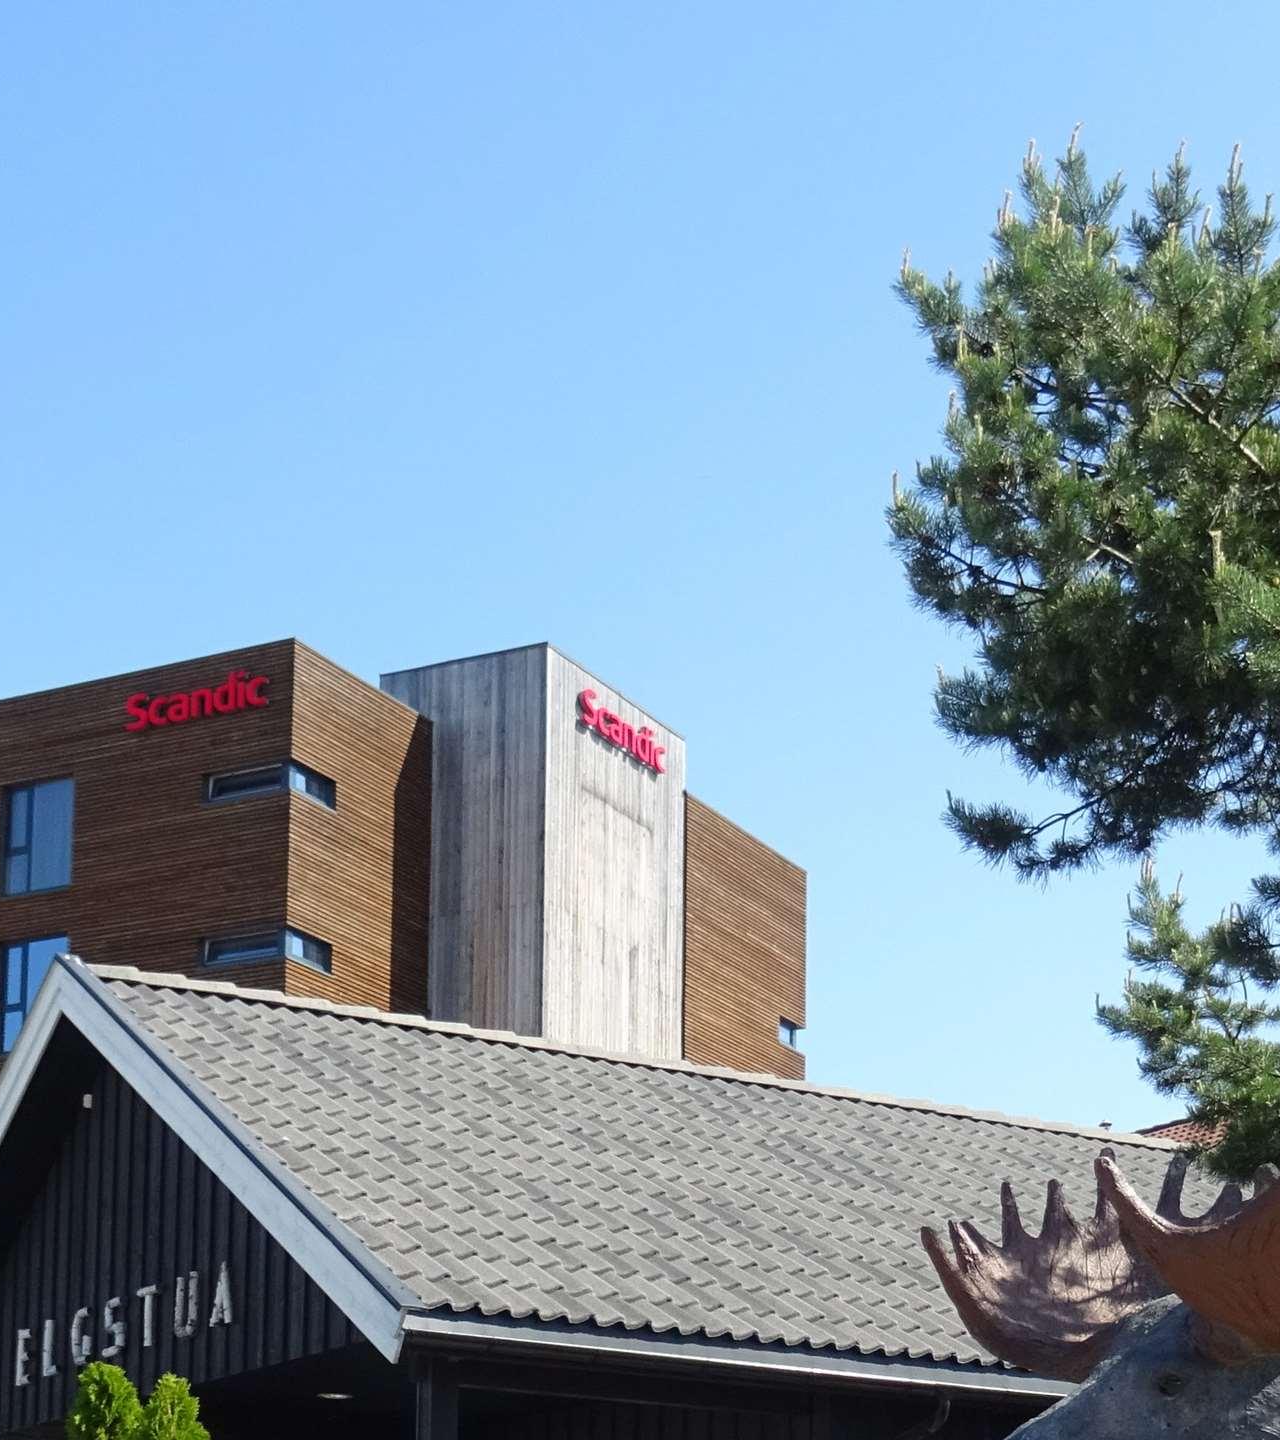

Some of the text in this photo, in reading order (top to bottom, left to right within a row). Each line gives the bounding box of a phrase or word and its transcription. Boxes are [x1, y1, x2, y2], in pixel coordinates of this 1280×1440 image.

[124, 669, 270, 732] Scandic
[578, 689, 666, 775] Scandic
[15, 1260, 233, 1387] ELGSTUA
